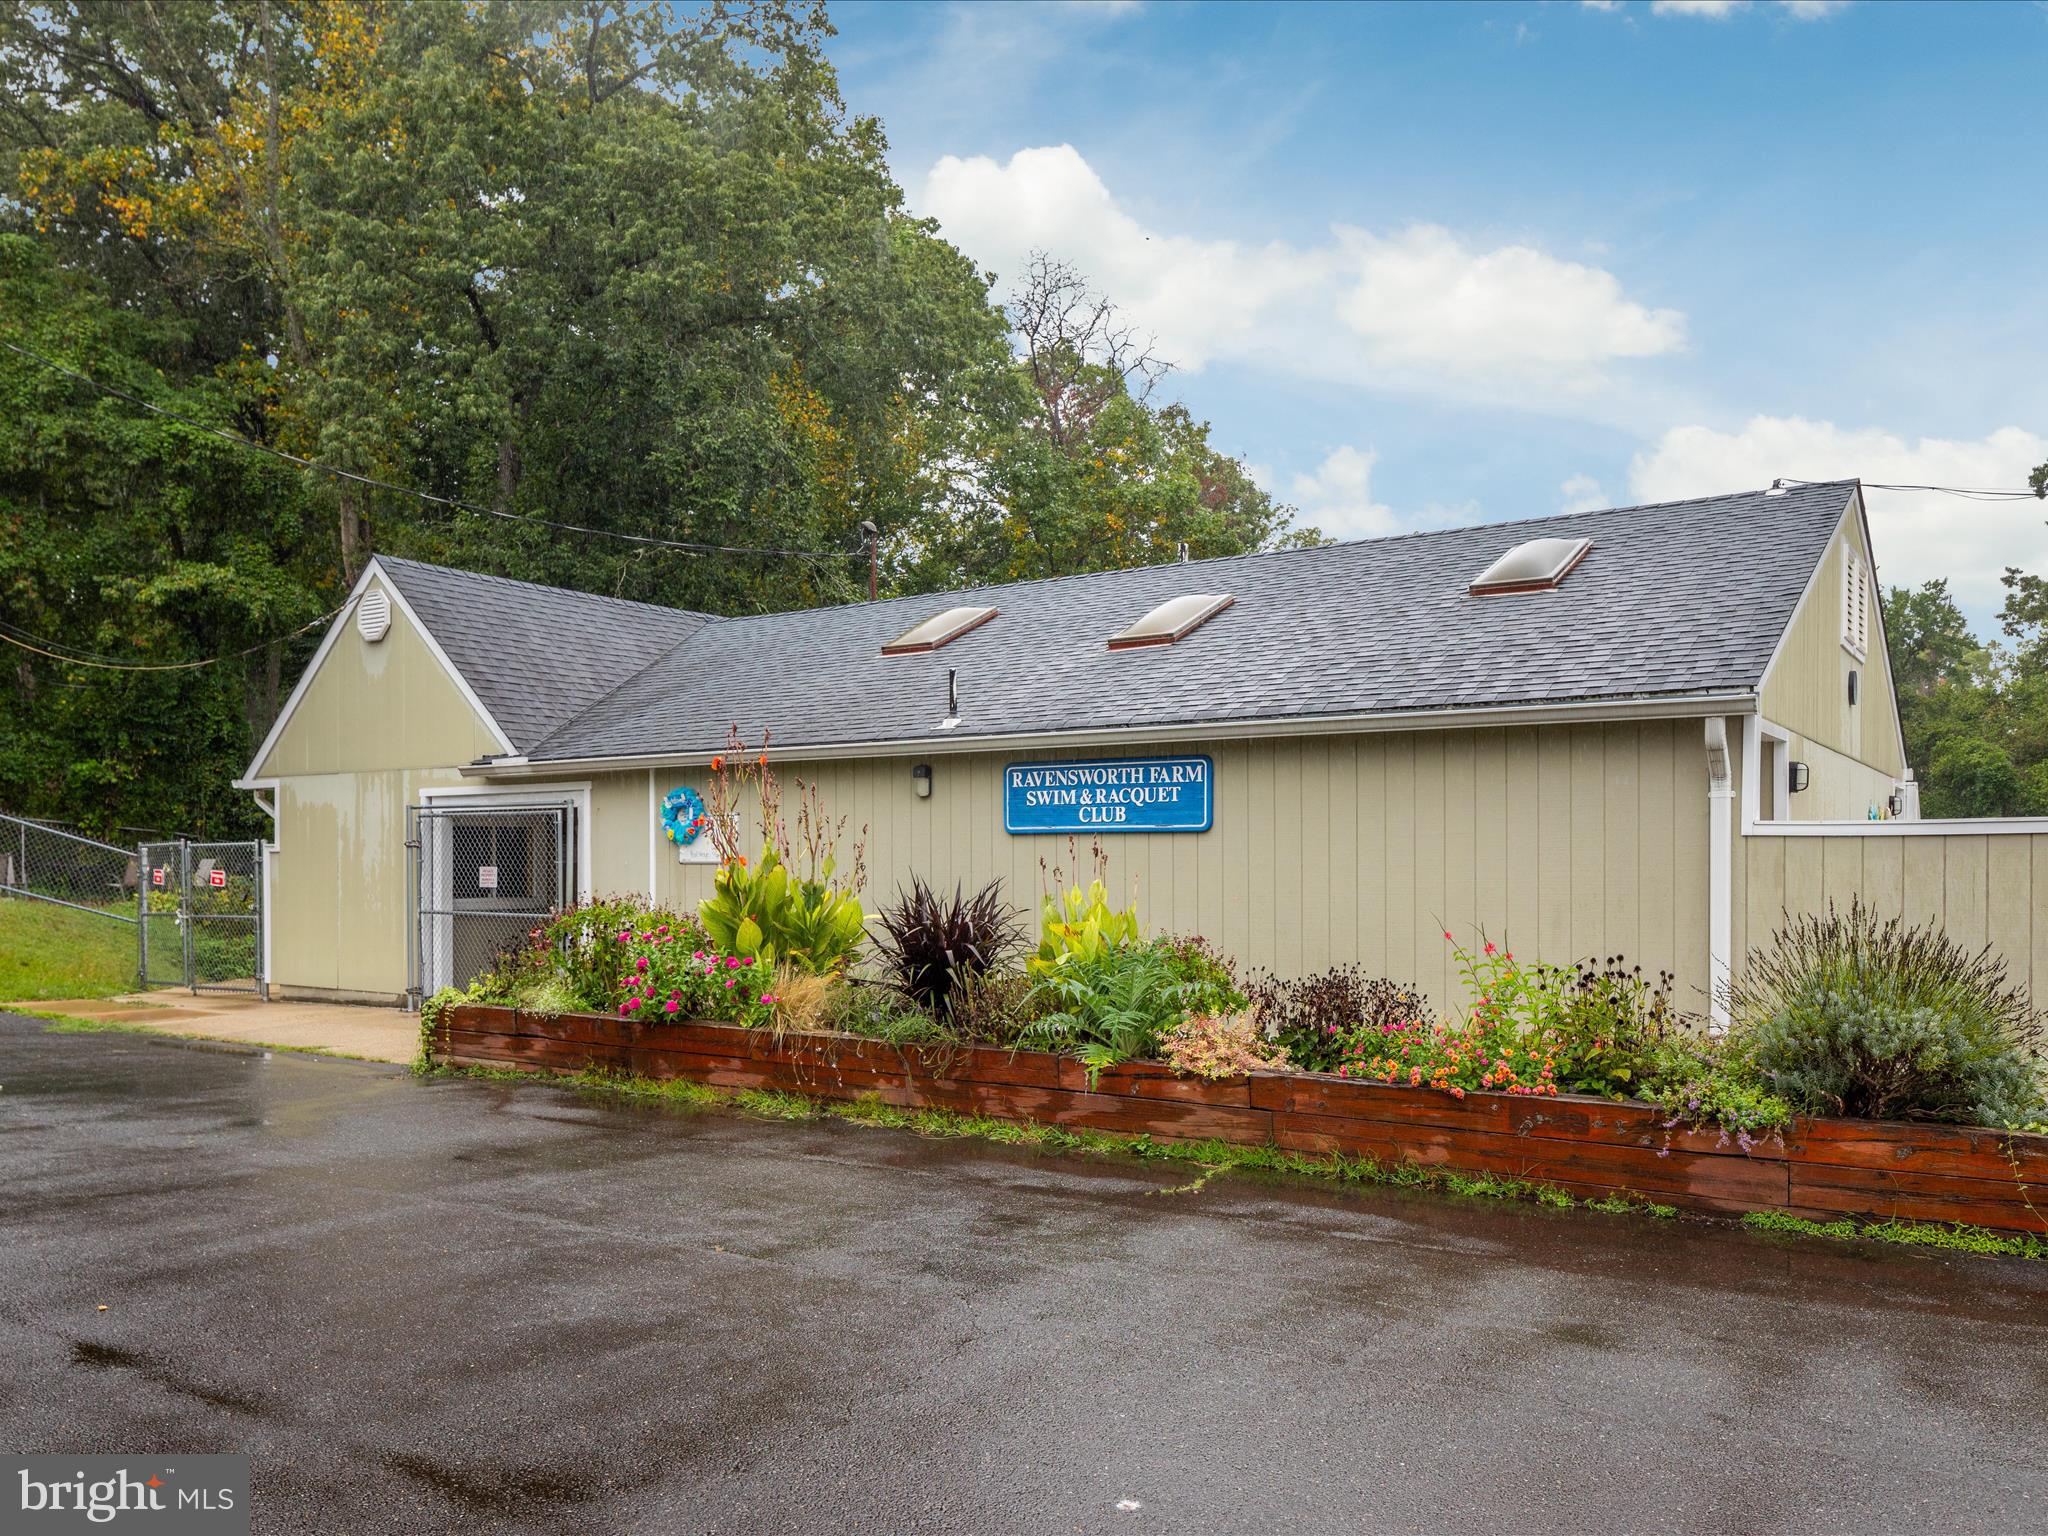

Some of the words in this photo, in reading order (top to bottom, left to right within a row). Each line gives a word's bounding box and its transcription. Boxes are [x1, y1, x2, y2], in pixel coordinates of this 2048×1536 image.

[1012, 767, 1144, 788] RAVENSWORTH
[1149, 765, 1204, 784] FARM
[1026, 789, 1077, 806] SWIM
[1095, 786, 1181, 806] RACQUET
[1078, 806, 1127, 822] CLUB
